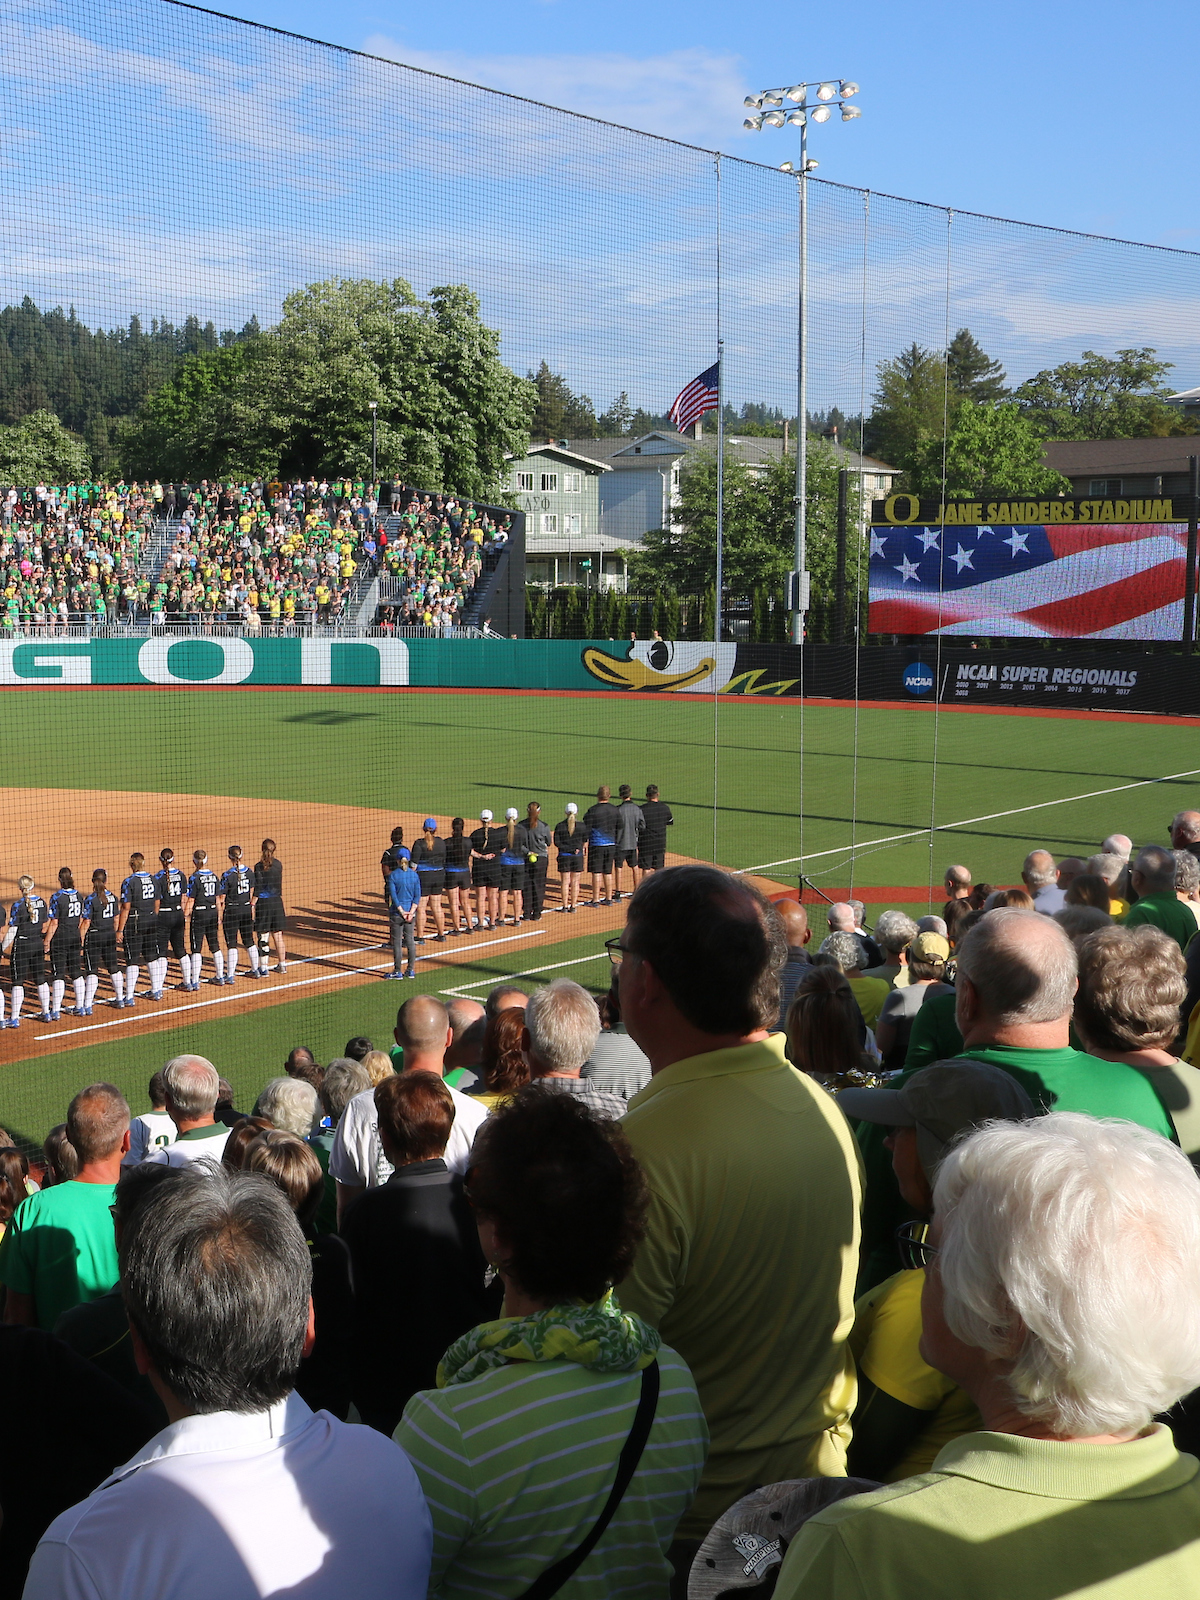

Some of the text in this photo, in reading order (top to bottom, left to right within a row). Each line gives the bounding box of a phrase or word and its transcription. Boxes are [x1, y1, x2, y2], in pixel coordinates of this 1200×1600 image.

[935, 500, 1173, 522] JANE SANDERS STADIUM
[905, 677, 933, 687] NCAA
[957, 664, 1138, 687] NCAA SUPER REGIONALS
[143, 884, 155, 899] 22
[169, 882, 181, 896] 44
[203, 883, 215, 897] 30
[68, 902, 81, 918] 28
[743, 1539, 781, 1574] CHAMPIONS
